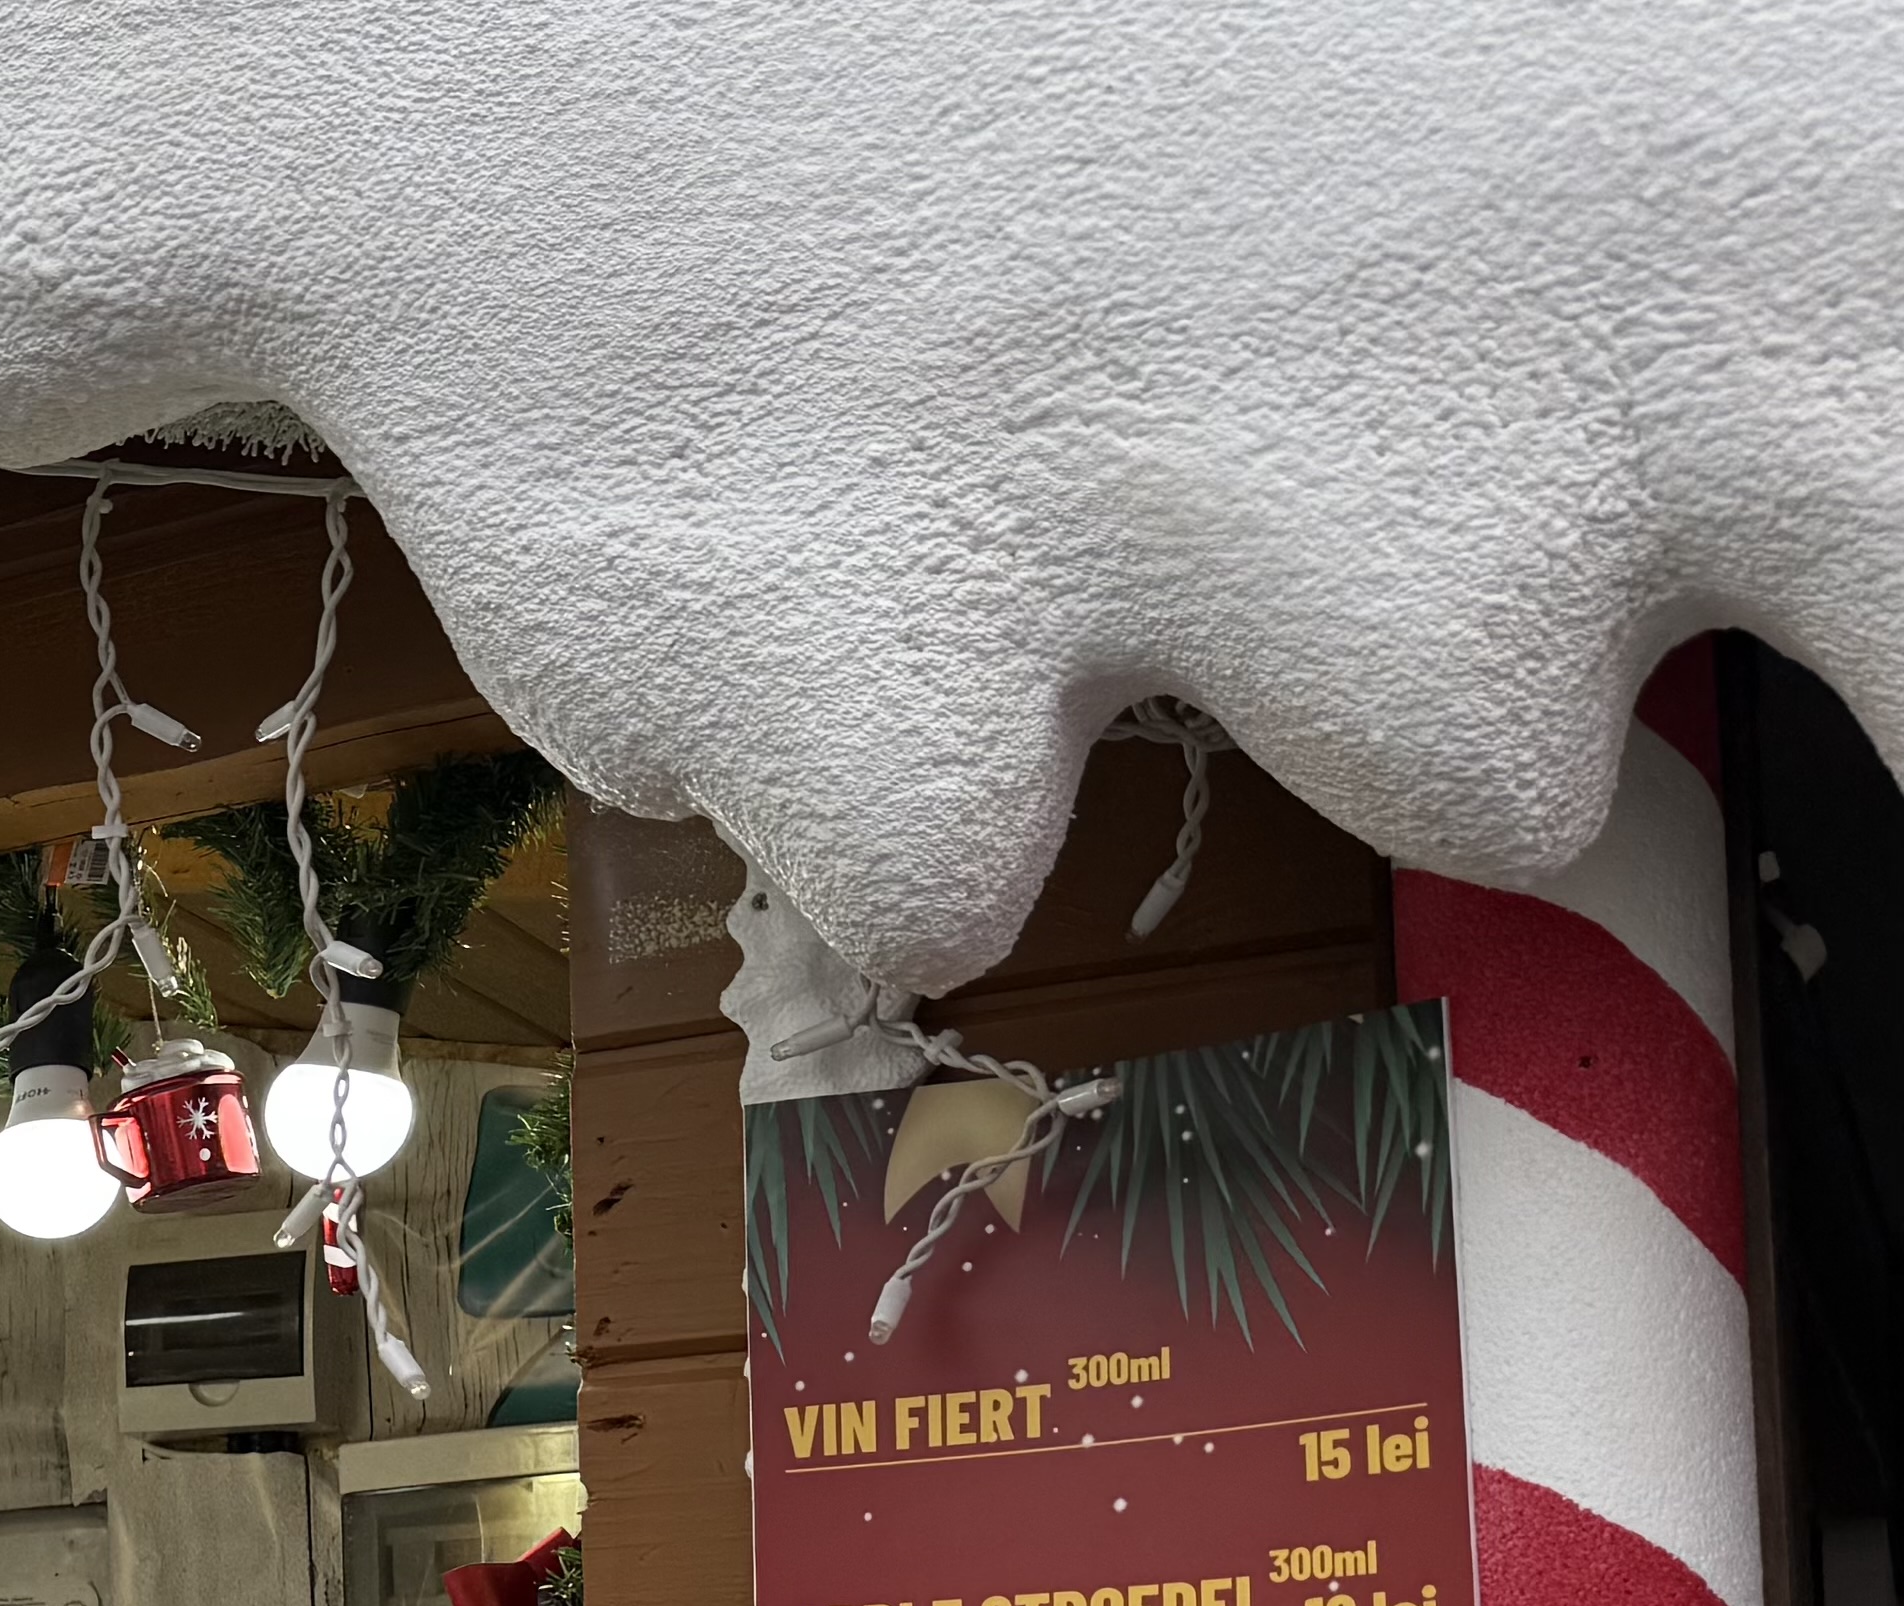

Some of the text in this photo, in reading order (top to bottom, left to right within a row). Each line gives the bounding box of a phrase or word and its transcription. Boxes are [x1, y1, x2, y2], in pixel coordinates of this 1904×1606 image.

[785, 1347, 1171, 1459] VIN FIERT 300ml
[1300, 1417, 1430, 1481] 15 lei
[1269, 1541, 1377, 1584] 300ml
